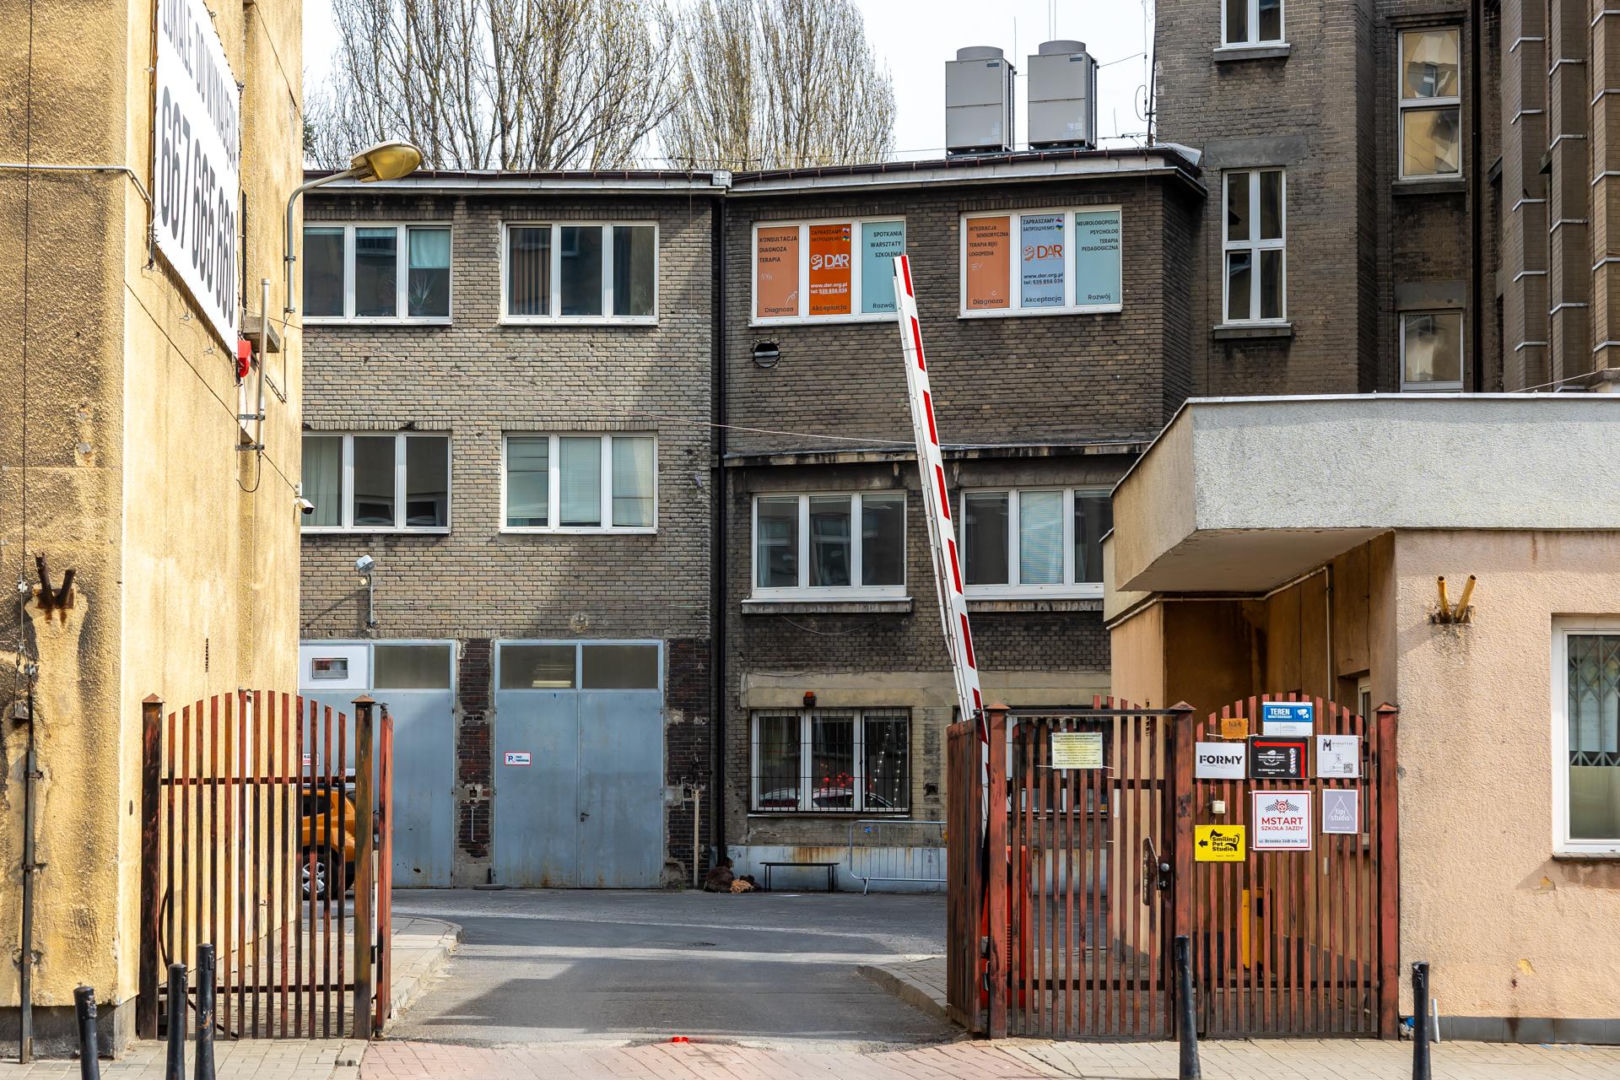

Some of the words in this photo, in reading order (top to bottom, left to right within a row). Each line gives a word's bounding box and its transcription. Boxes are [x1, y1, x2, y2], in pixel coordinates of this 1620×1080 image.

[161, 85, 191, 249] 667
[192, 138, 215, 293] 665
[216, 186, 234, 329] 660
[870, 240, 901, 248] WARSZTATY
[1036, 244, 1063, 259] DAR
[824, 253, 849, 268] DAR
[1024, 296, 1063, 304] Akceptacja
[1087, 292, 1112, 301] Rozwój
[1270, 708, 1291, 716] TEREN
[1199, 755, 1243, 765] FORMY
[1261, 816, 1304, 826] MSTART
